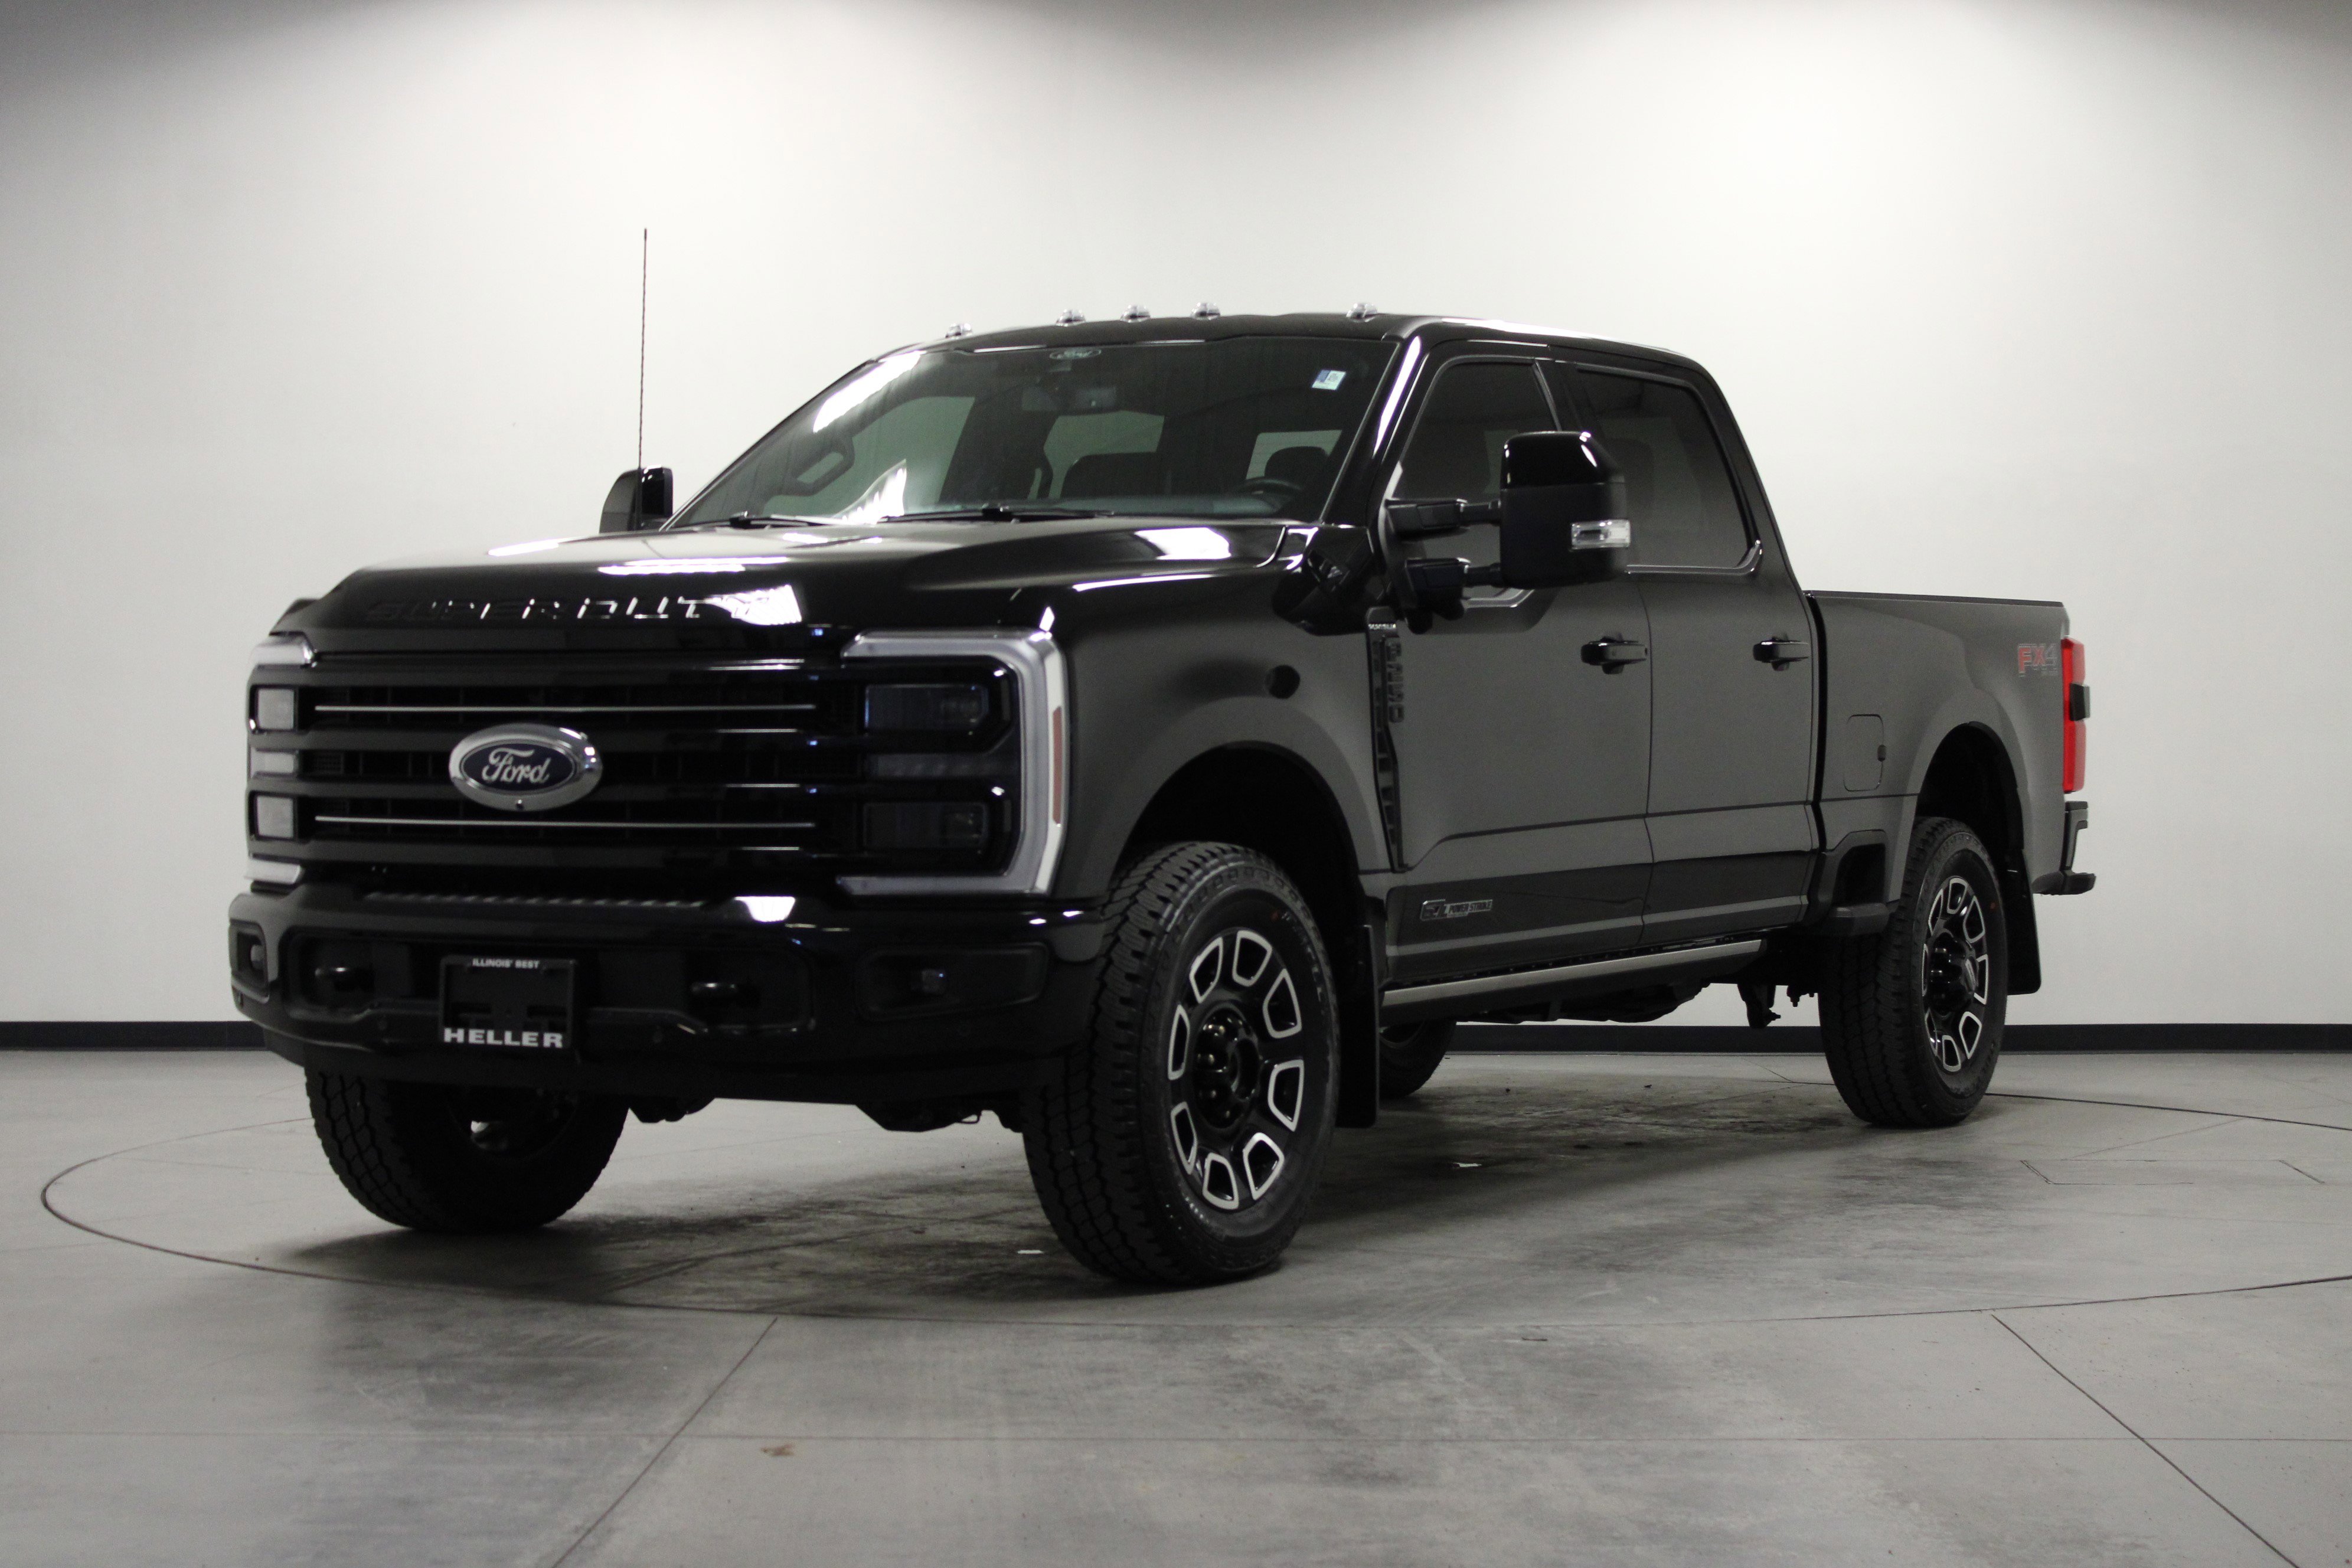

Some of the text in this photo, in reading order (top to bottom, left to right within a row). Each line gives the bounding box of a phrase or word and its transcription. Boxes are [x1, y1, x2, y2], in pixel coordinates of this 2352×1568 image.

[2018, 643, 2058, 677] FX4
[481, 747, 552, 784] Ford
[443, 1027, 563, 1049] HELLER
